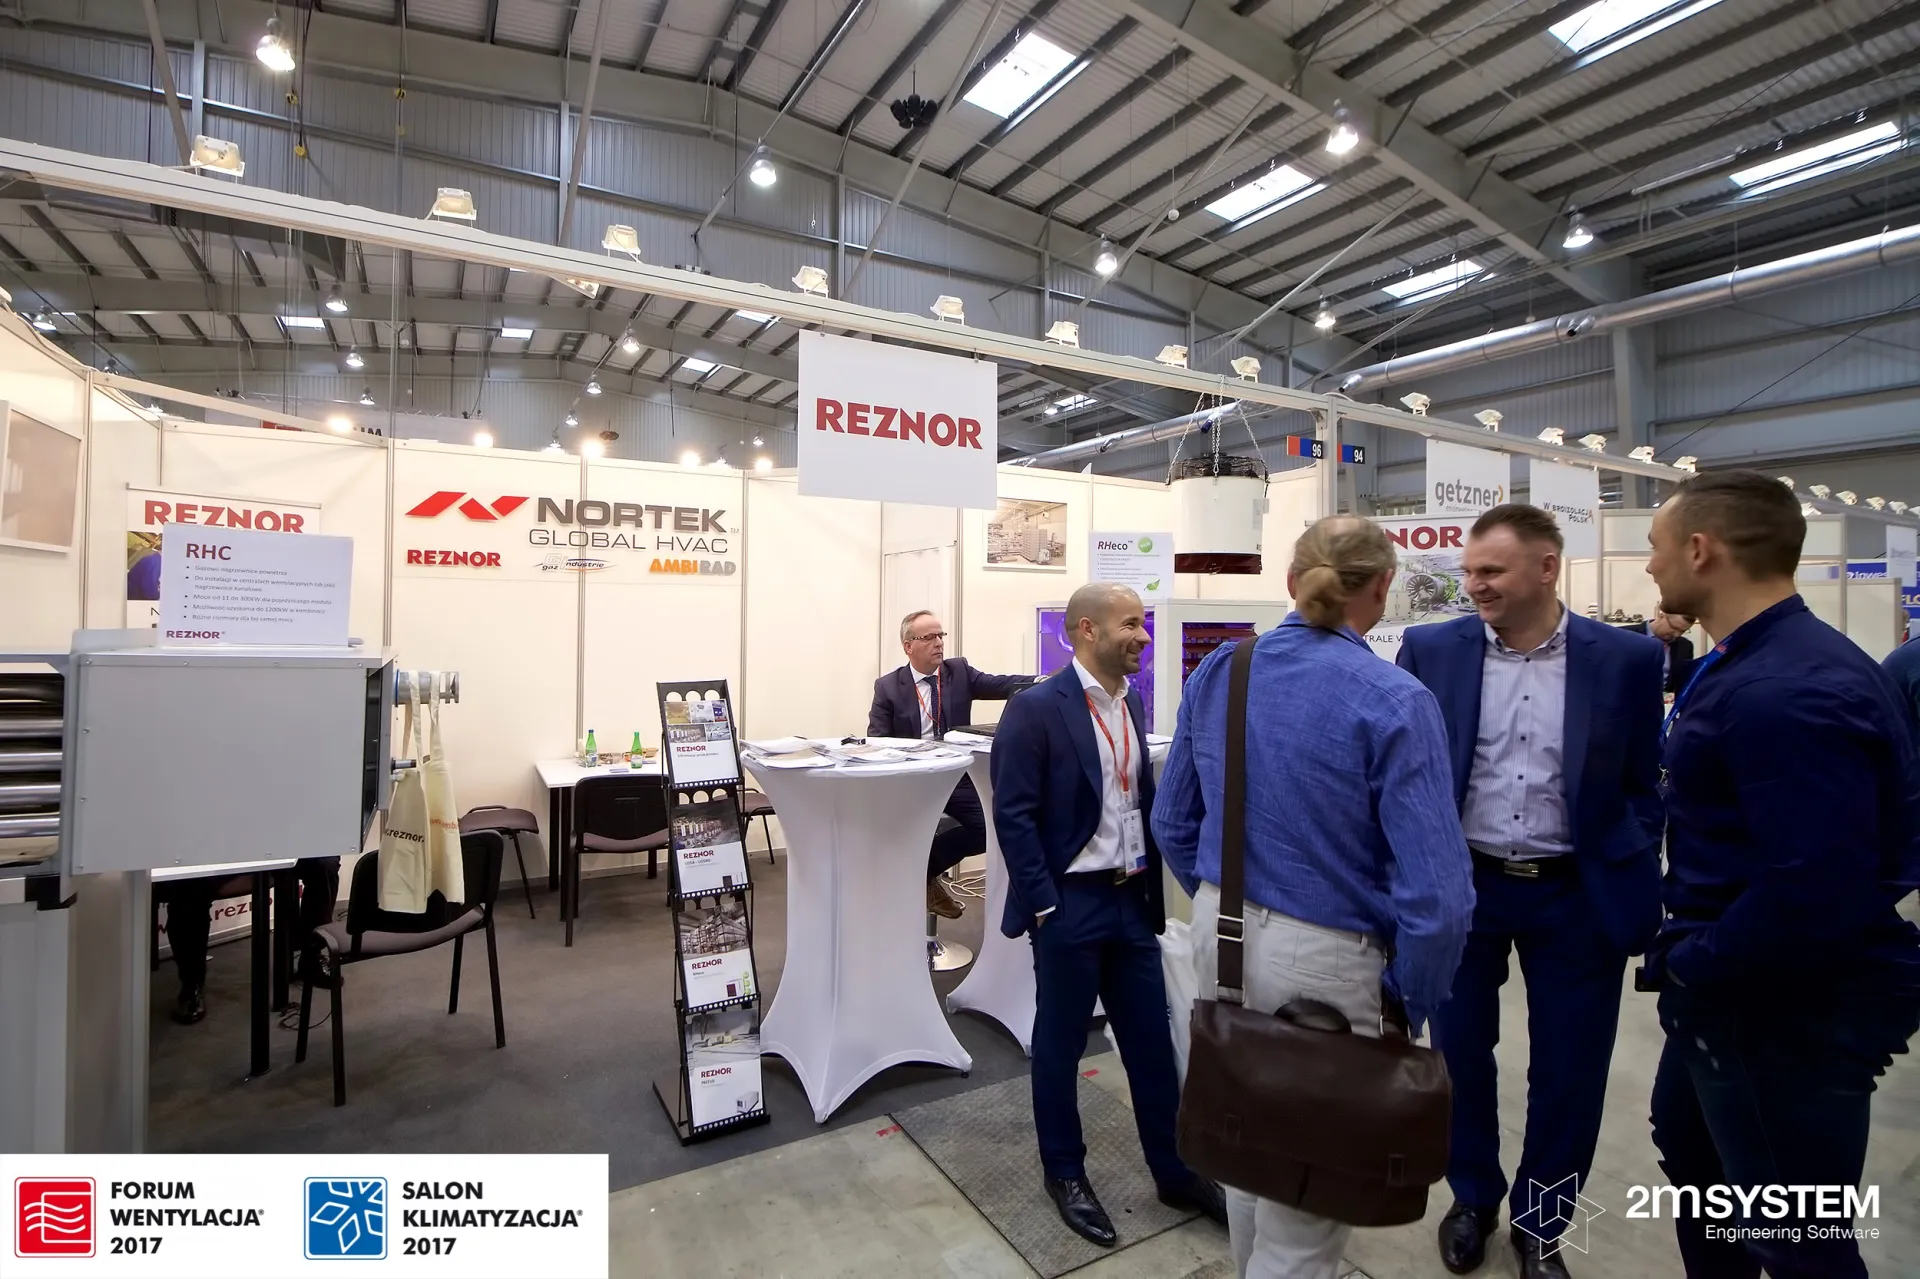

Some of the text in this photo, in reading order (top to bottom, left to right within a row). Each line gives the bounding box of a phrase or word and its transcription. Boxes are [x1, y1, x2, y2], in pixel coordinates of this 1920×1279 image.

[816, 397, 983, 450] REZNOR
[1312, 443, 1322, 457] 96
[1354, 449, 1364, 463] 94
[1435, 479, 1499, 507] getzner
[145, 499, 305, 534] REZNOR
[537, 496, 728, 533] NORTEK
[529, 528, 728, 554] GLOBAL HVAC
[1097, 541, 1128, 550] RHeco
[186, 543, 232, 561] RHC
[407, 549, 502, 567] REZNOR
[221, 567, 258, 575] nagrzewnice
[676, 745, 707, 753] REZNOR
[683, 850, 714, 860] REZNOR
[691, 958, 723, 970] REZNOR
[700, 1067, 732, 1079] REZNOR
